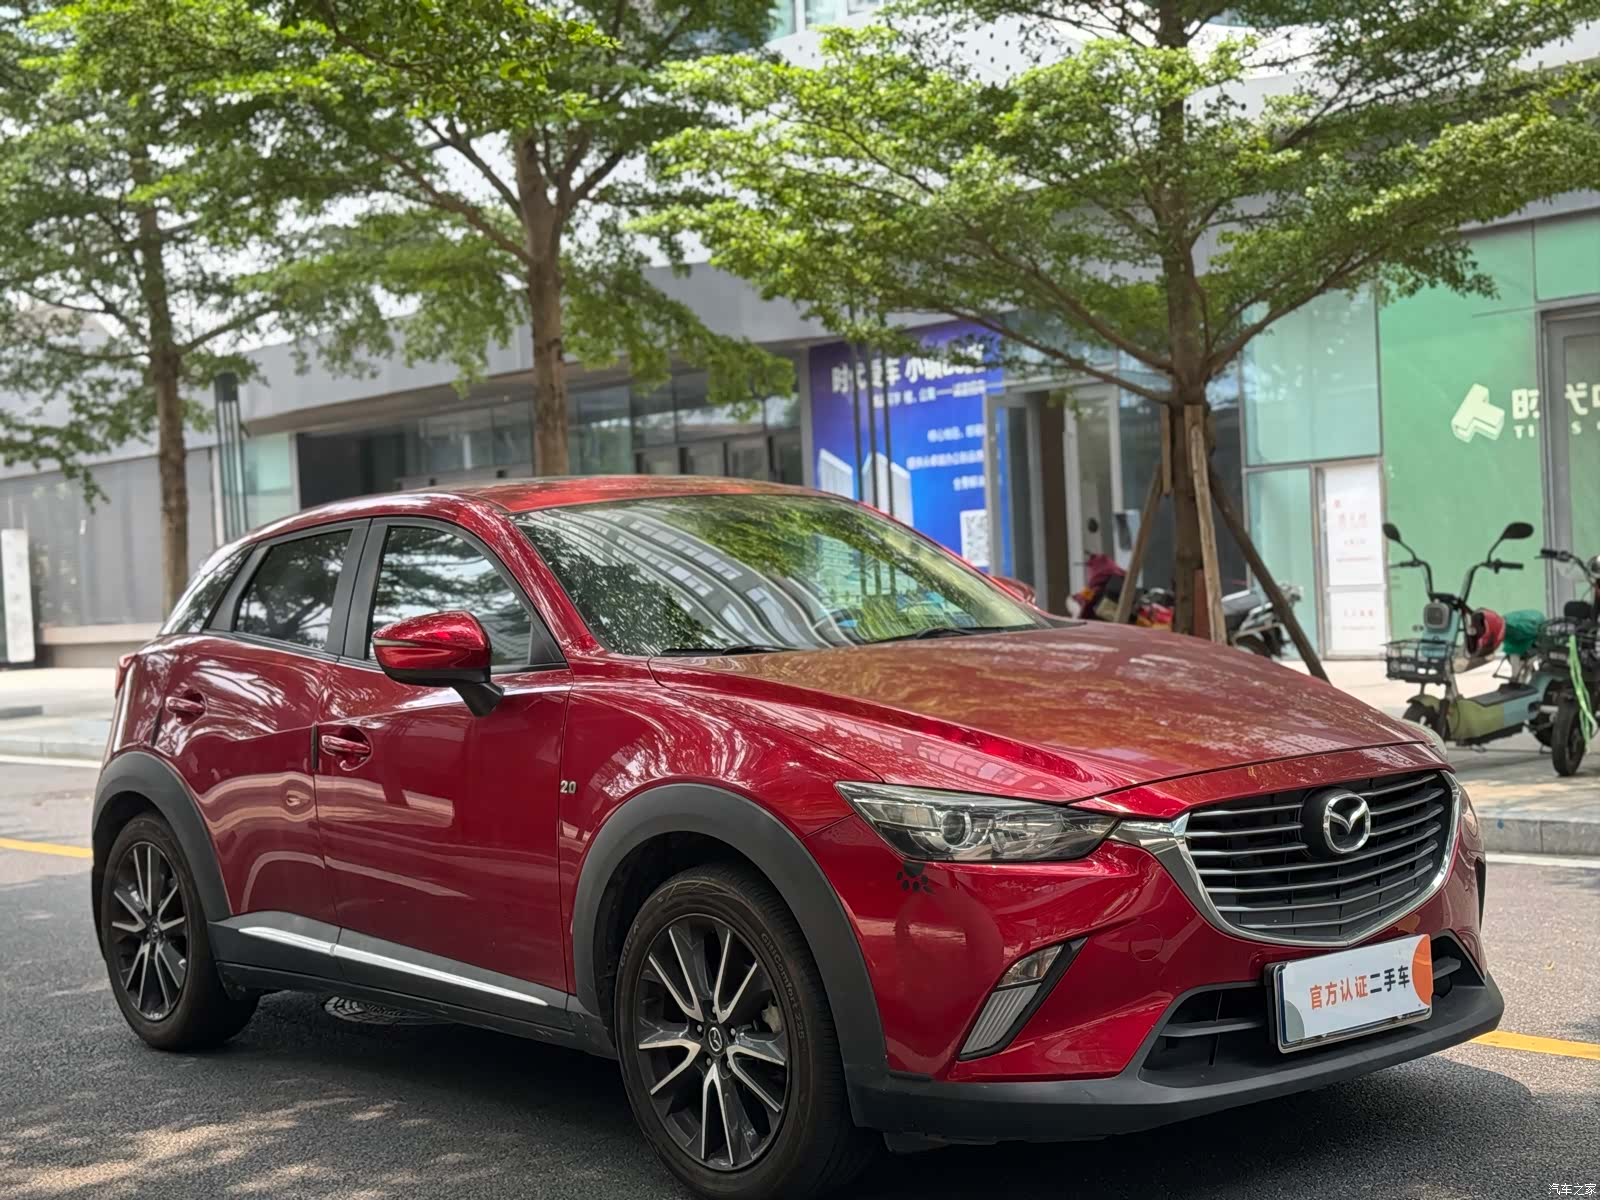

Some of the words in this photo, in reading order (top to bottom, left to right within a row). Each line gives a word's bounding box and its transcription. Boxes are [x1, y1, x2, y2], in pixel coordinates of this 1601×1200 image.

[1309, 965, 1411, 1011] 官方认证二手车
